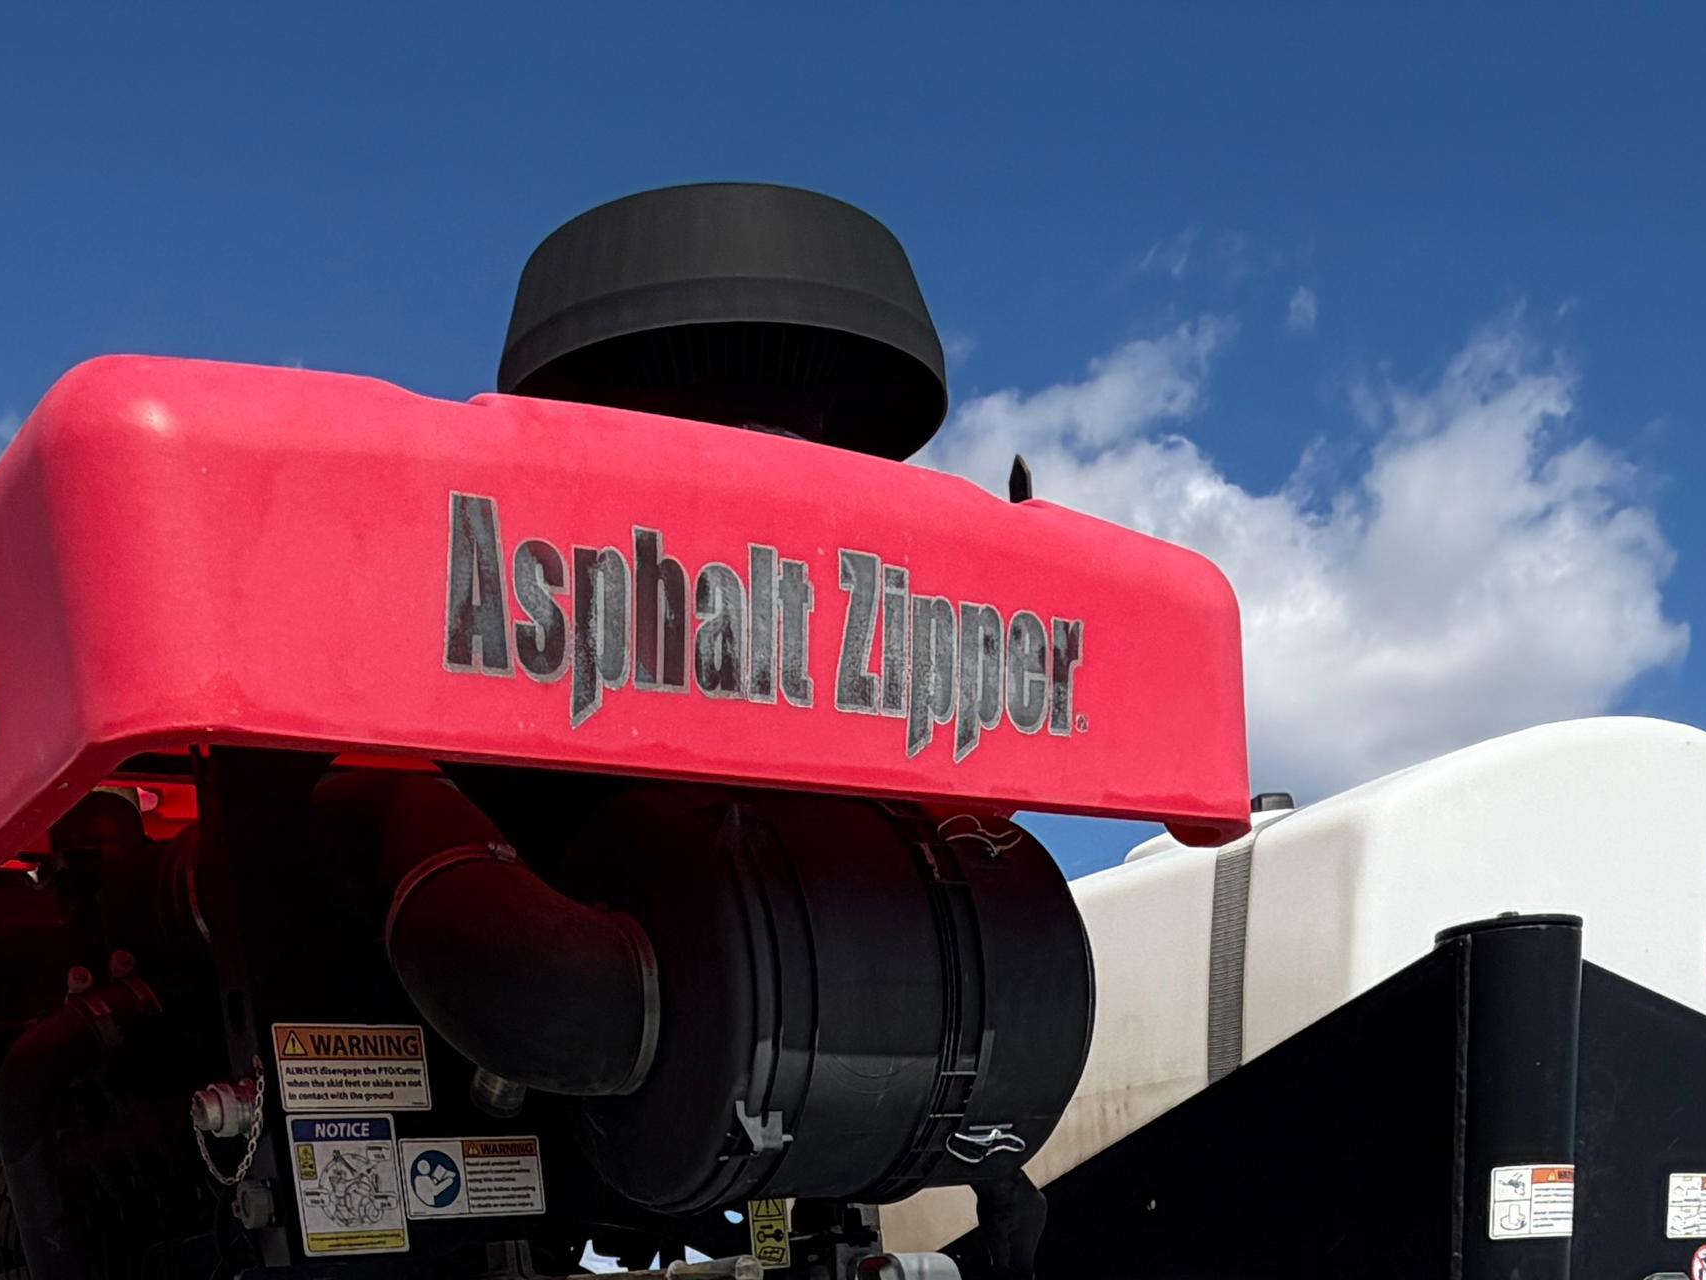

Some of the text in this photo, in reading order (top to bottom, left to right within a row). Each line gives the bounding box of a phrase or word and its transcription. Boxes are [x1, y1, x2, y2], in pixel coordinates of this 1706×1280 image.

[443, 490, 1084, 762] Asphalt Zipper
[309, 1034, 420, 1057] WARNING
[363, 1067, 376, 1075] the
[311, 1079, 325, 1087] the
[350, 1092, 363, 1100] the
[315, 1122, 371, 1138] NOTICE
